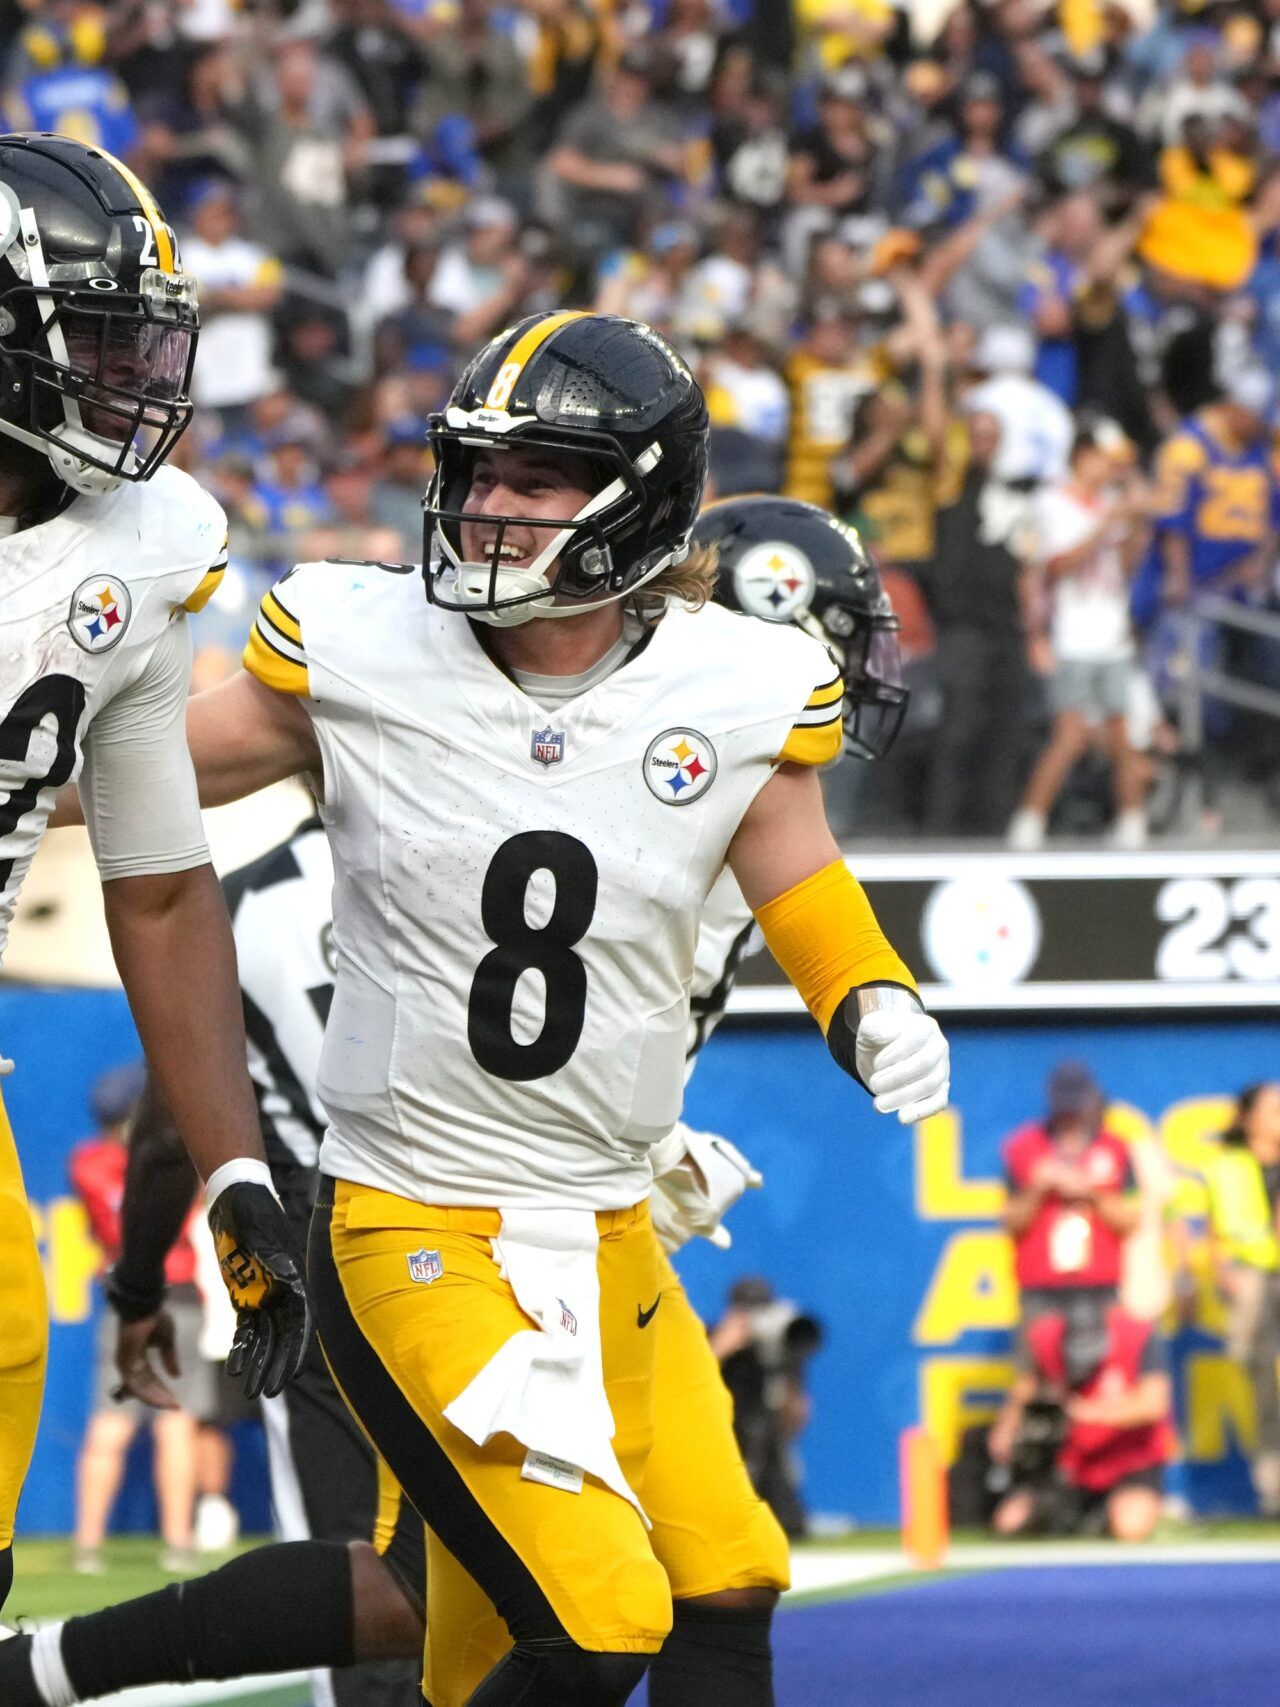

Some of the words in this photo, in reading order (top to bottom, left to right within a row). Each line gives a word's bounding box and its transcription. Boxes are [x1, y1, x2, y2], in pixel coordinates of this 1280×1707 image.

[486, 362, 521, 408] 8
[78, 600, 100, 616] Steelers
[536, 745, 559, 760] NFL
[651, 756, 680, 770] Steelers
[1155, 877, 1280, 980] 23
[467, 830, 599, 1082] 8
[414, 1262, 438, 1278] NFL
[560, 1310, 576, 1334] NFL
